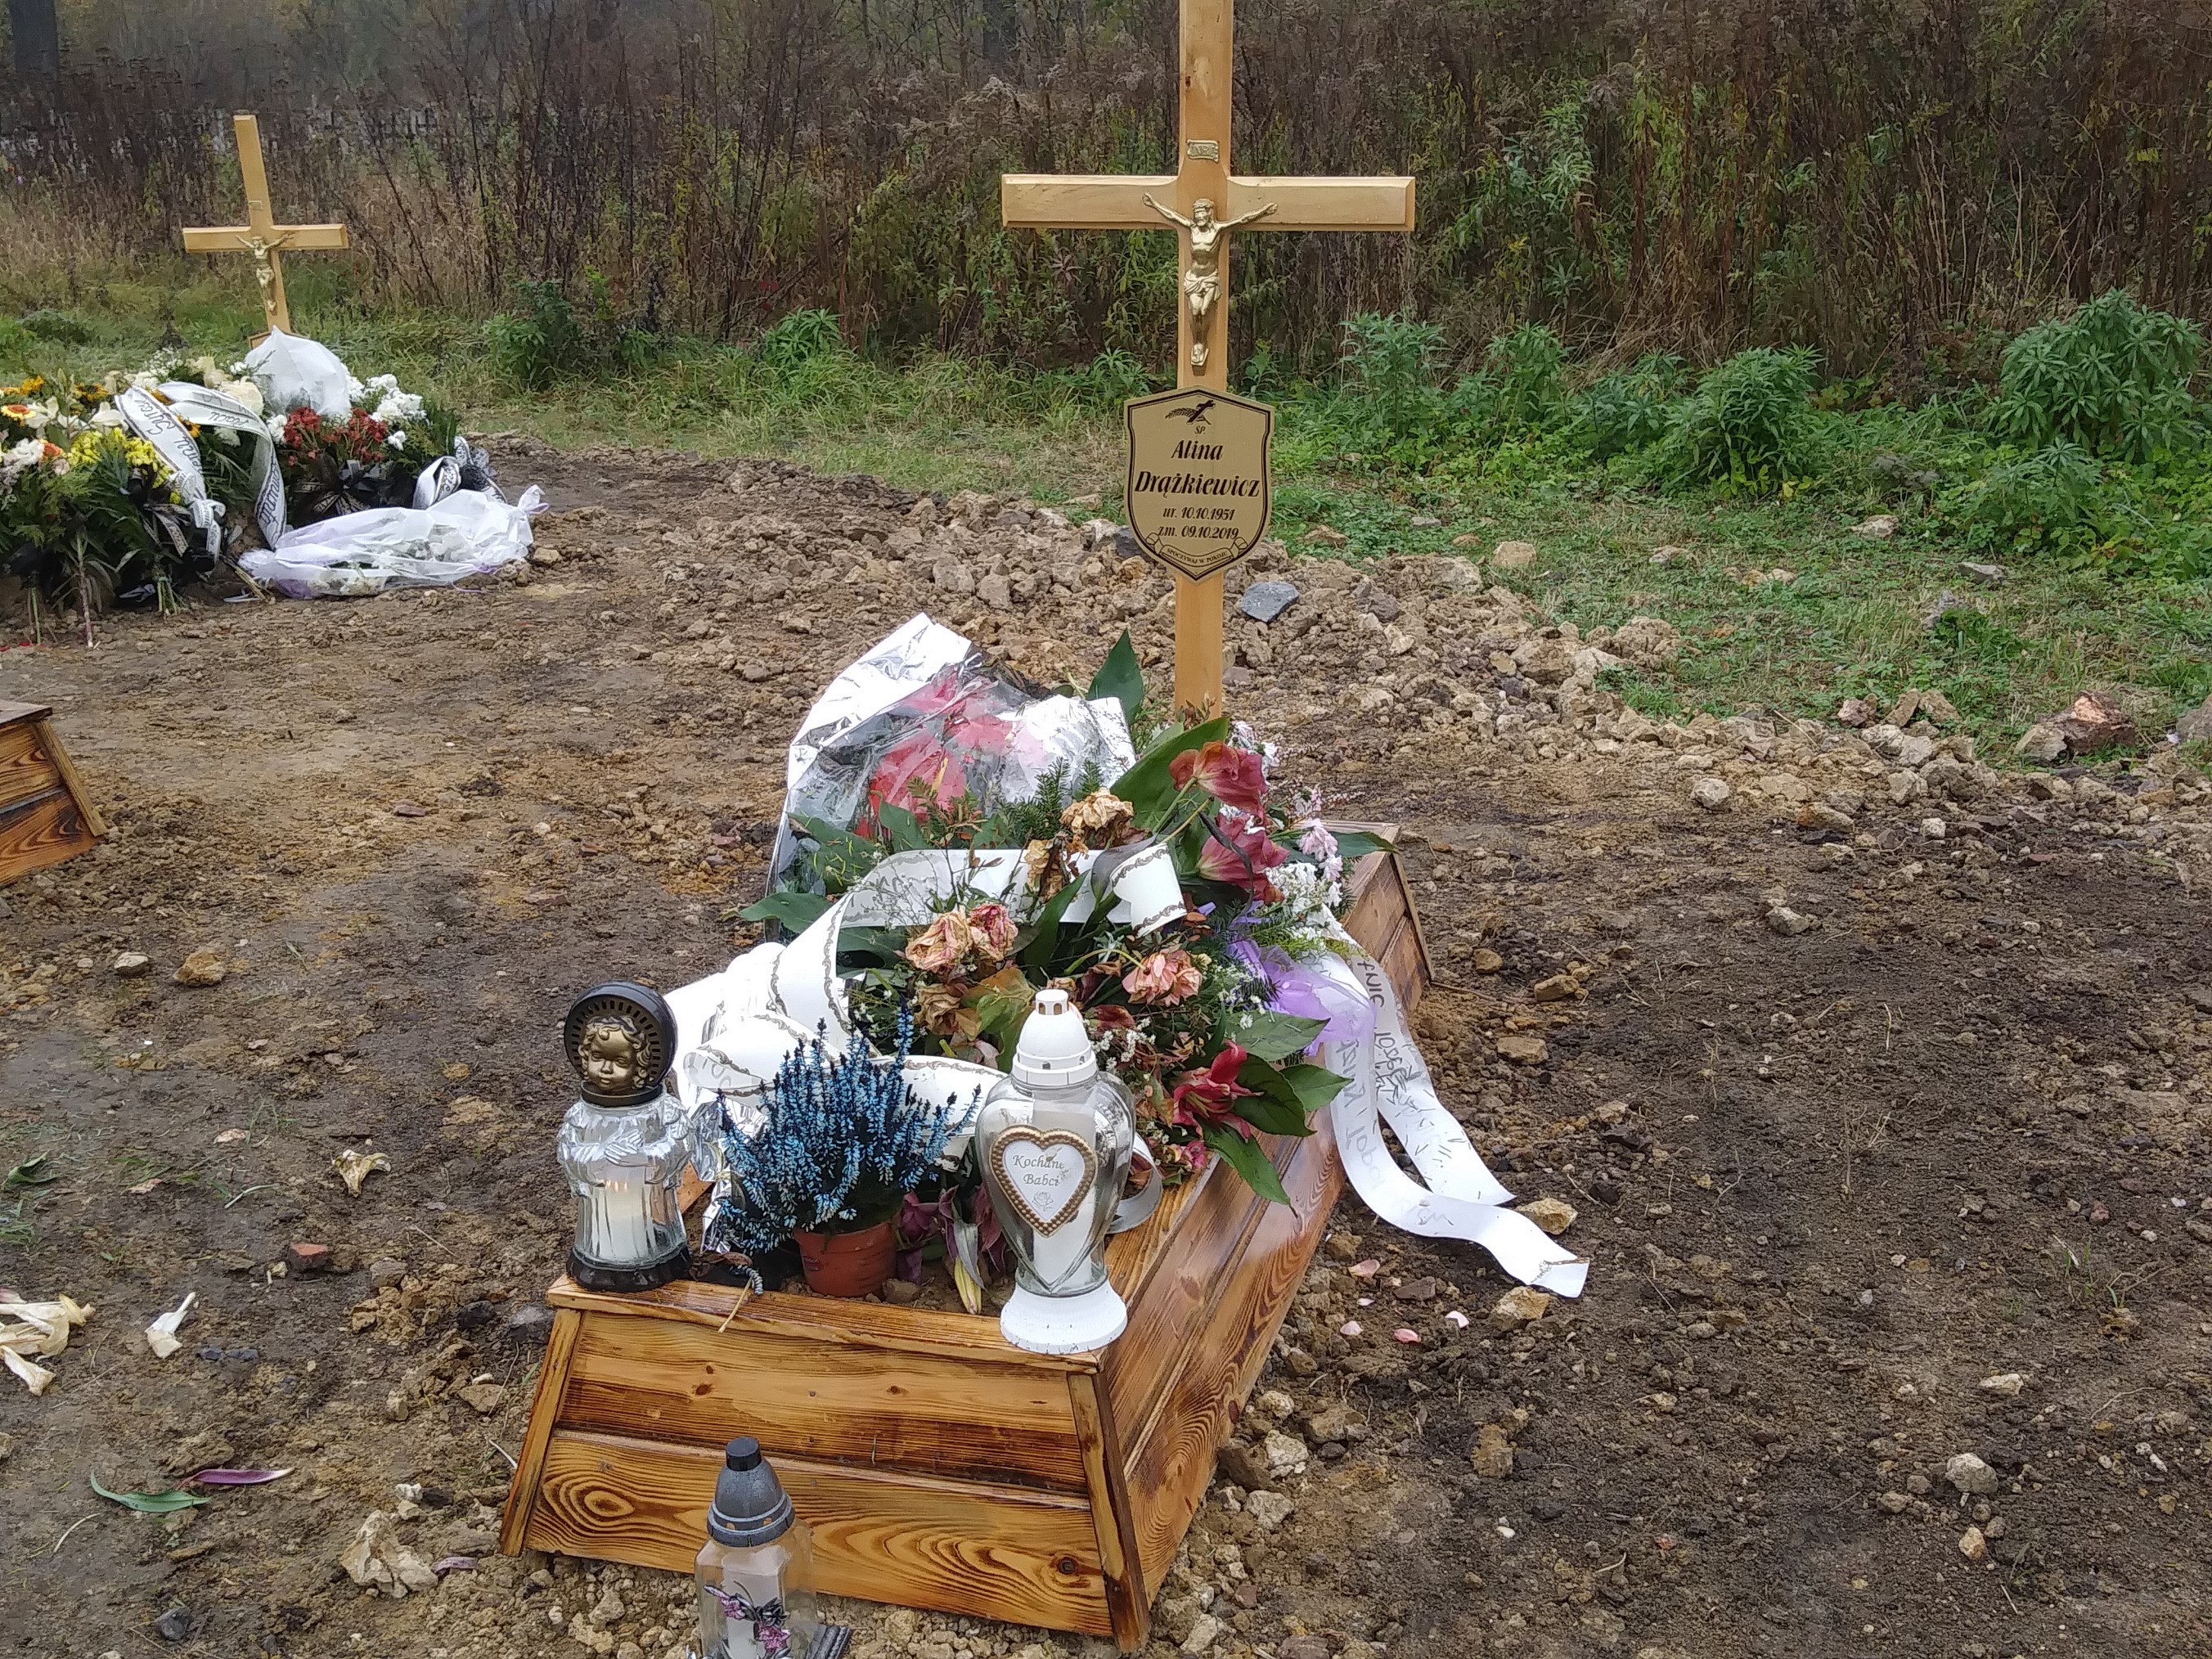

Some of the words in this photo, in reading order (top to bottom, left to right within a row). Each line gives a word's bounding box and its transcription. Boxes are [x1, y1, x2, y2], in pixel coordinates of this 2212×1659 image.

[1170, 439, 1225, 461] Alina
[1134, 470, 1261, 499] Drążkiewicz
[1162, 507, 1178, 519] ur.
[1181, 506, 1236, 521] 10.10.1951
[1158, 525, 1178, 537] zm.
[1181, 525, 1239, 540] 09.10.2019
[1167, 548, 1198, 564] SPOCZYWAJ
[1206, 551, 1229, 563] POKOJU
[1023, 1173, 1061, 1187] Babci
